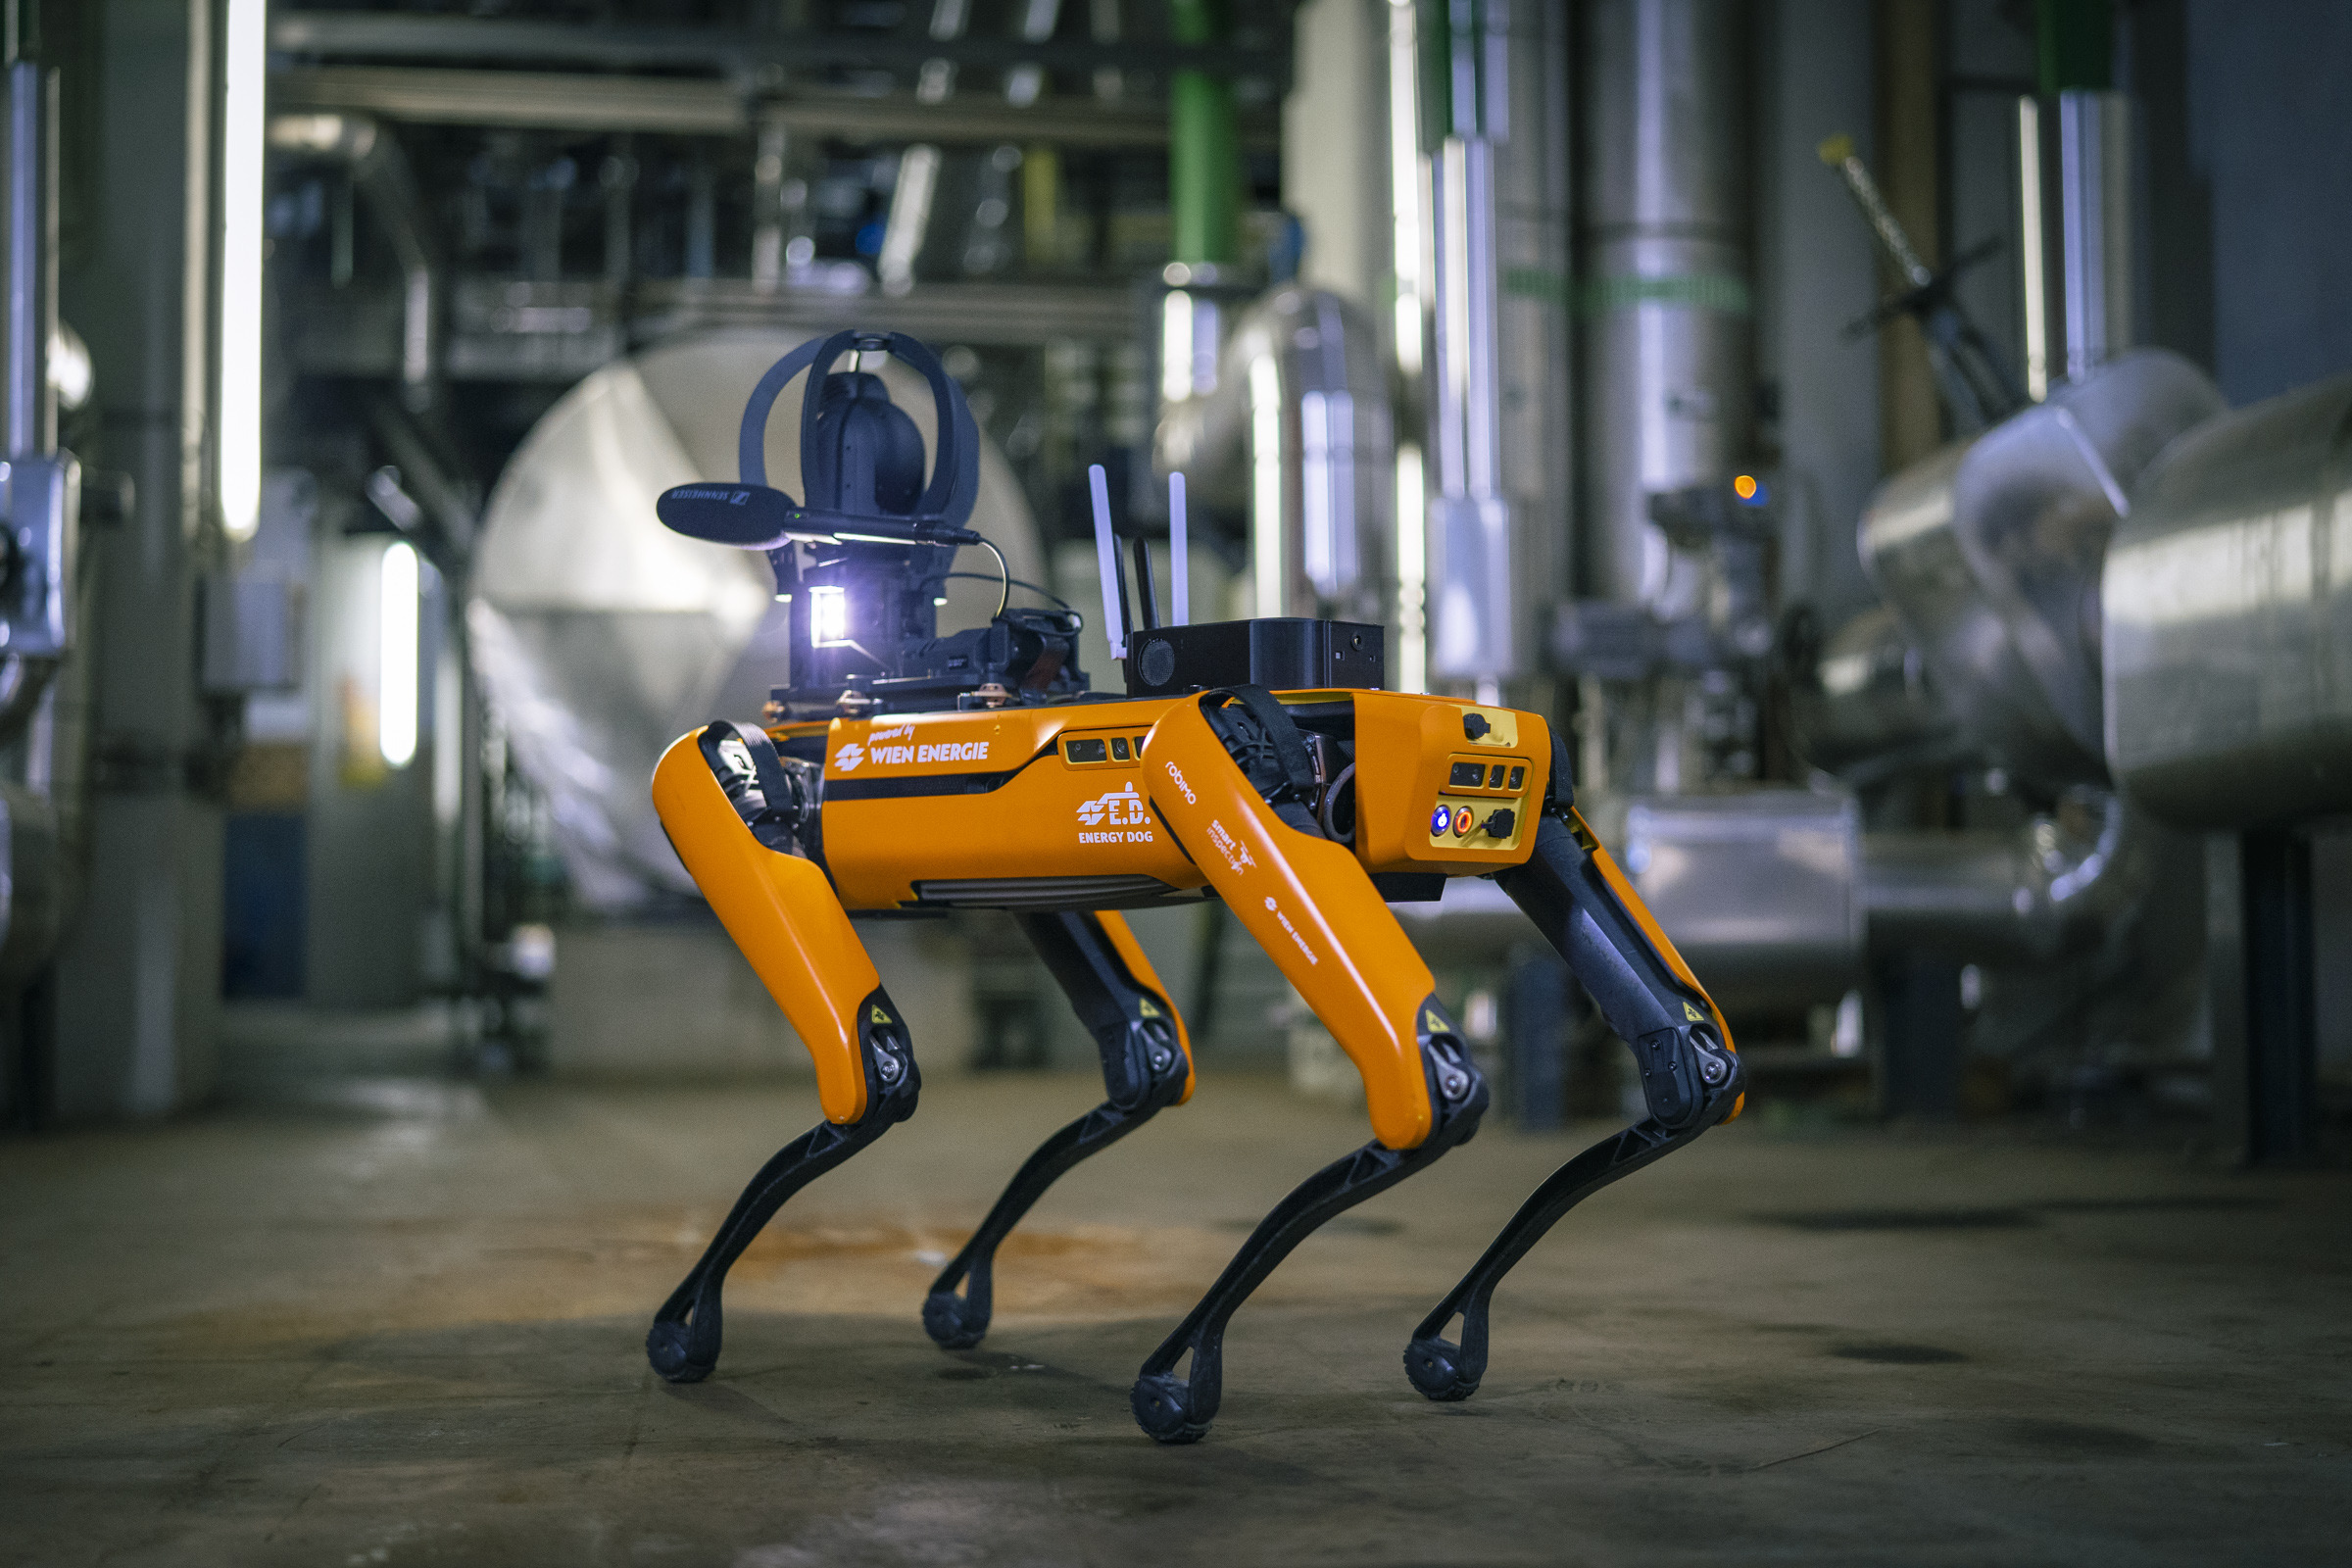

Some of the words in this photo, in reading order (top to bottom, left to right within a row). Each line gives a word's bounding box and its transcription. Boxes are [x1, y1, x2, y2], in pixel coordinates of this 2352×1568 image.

[671, 489, 729, 501] SENNHEISER
[867, 724, 904, 747] powered
[904, 723, 916, 741] by
[870, 745, 915, 764] WIEN
[916, 741, 990, 763] ENERGIE
[1108, 799, 1152, 825] E.D.
[1078, 831, 1125, 844] ENERGY
[1126, 830, 1154, 843] DOG
[1211, 819, 1237, 851] smart
